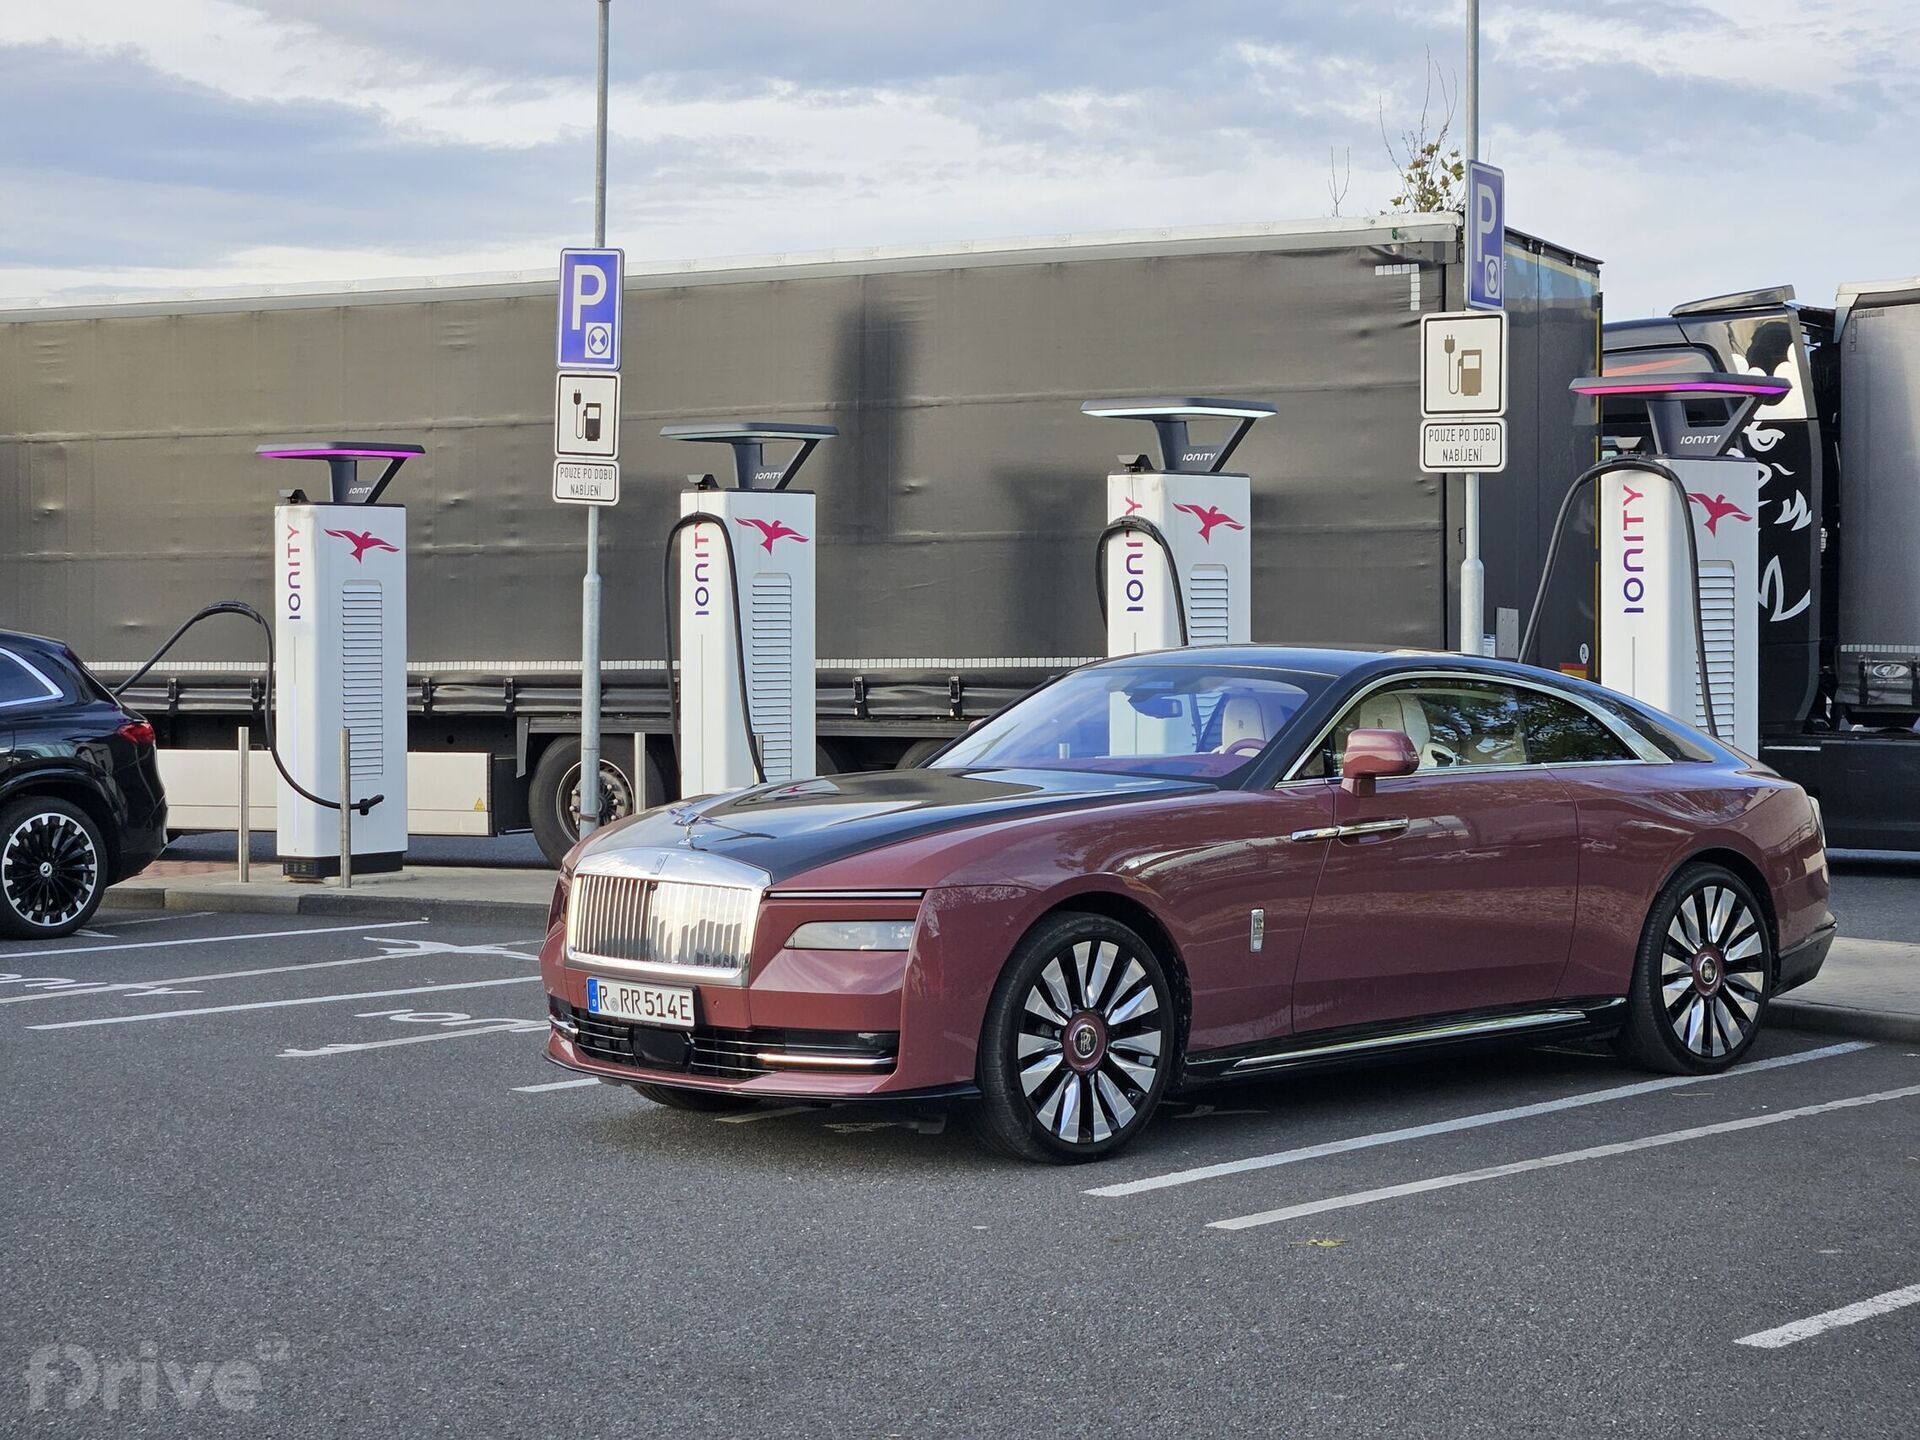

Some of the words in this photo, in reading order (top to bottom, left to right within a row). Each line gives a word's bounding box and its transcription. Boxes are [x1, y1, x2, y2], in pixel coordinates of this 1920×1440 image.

[1477, 183, 1497, 263] P
[572, 265, 607, 331] P
[1429, 428, 1456, 442] POUZE
[1459, 428, 1470, 442] PO
[1473, 428, 1497, 441] DOBU
[1680, 434, 1721, 445] IONITY
[1182, 453, 1216, 462] IONITY
[1442, 445, 1483, 462] NABÍJENÍ
[560, 467, 581, 479] POUZE
[583, 468, 592, 480] PO
[594, 468, 613, 480] DOBU
[570, 482, 602, 496] NABÍJENÍ
[1125, 497, 1144, 612] IONIY
[1623, 484, 1645, 613] IONITY
[287, 524, 301, 620] IONITY
